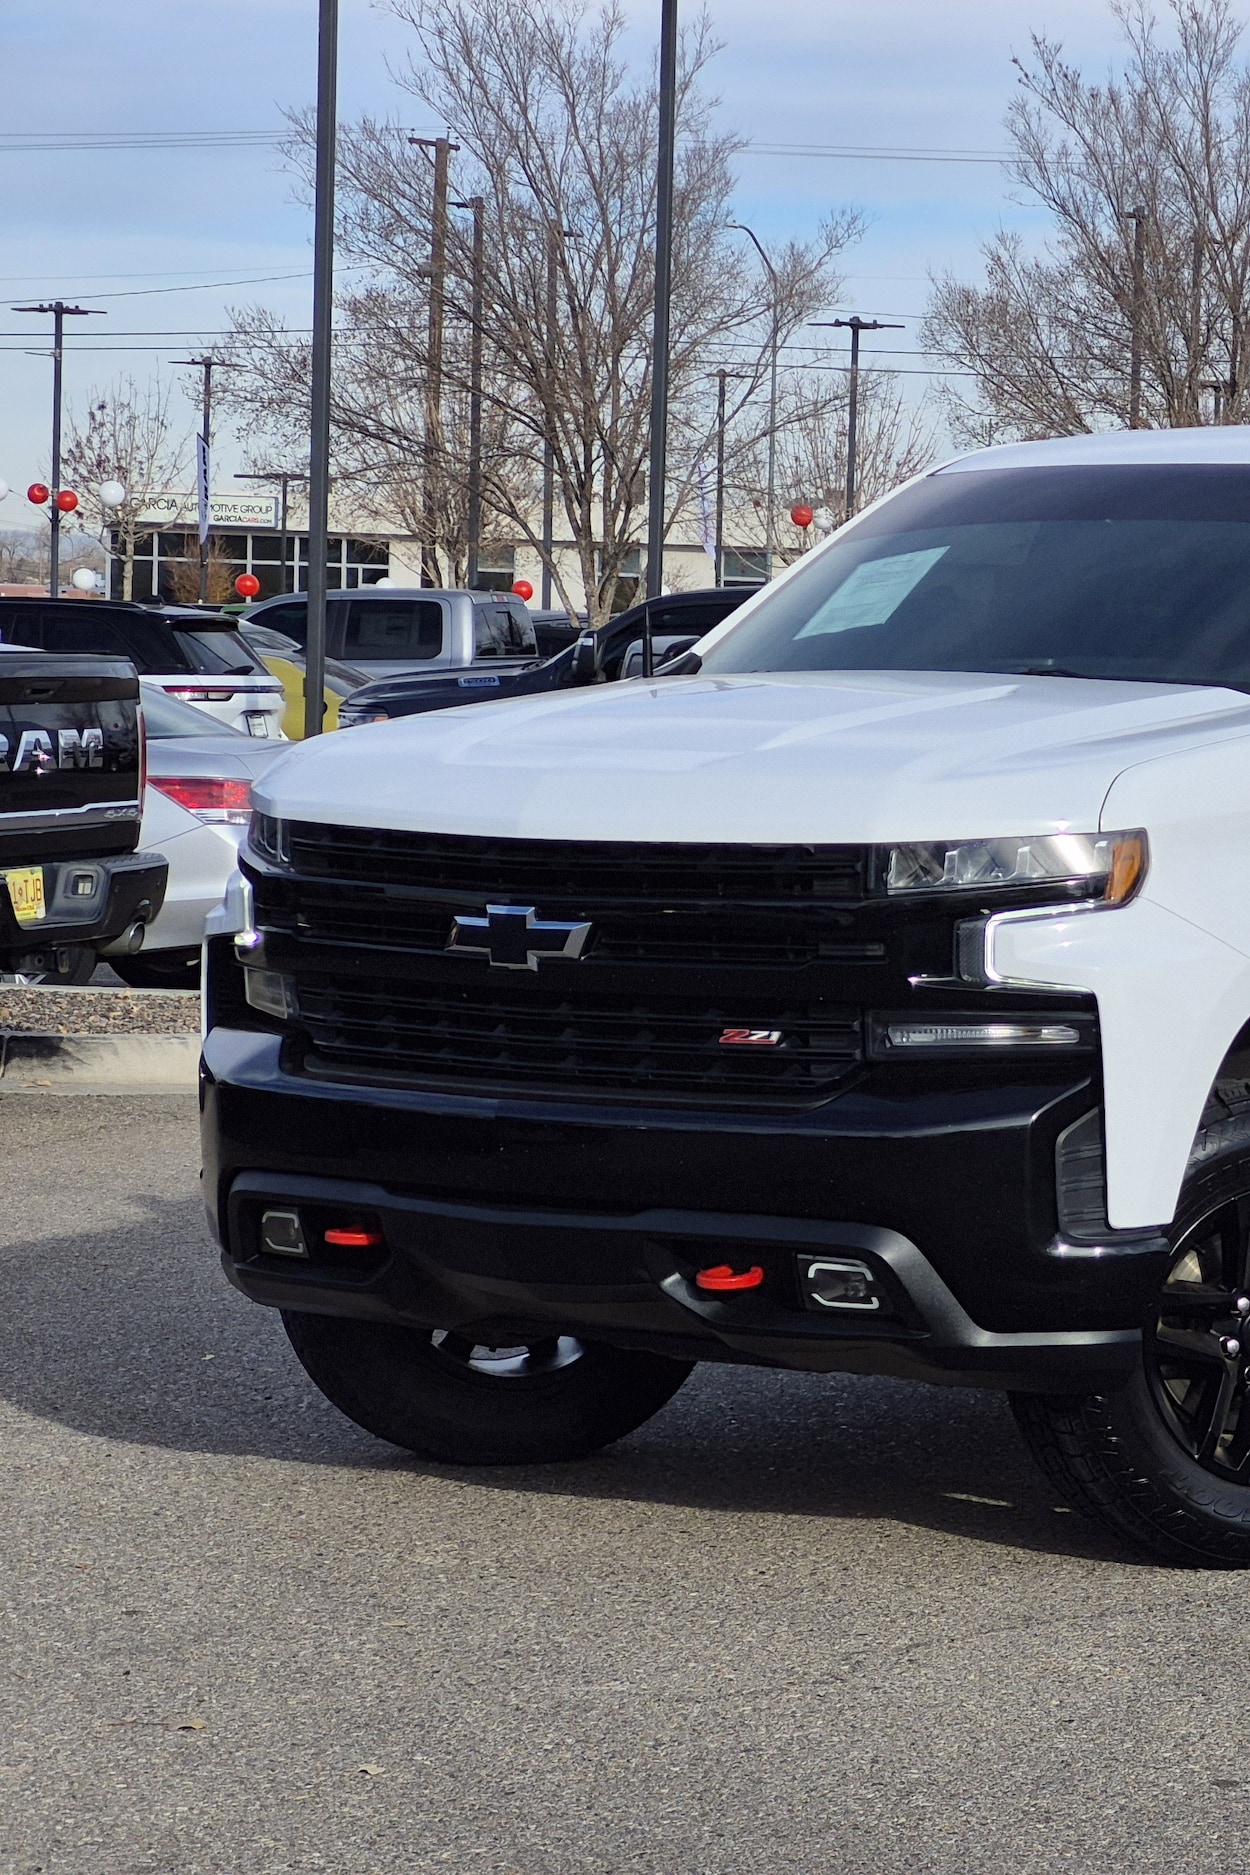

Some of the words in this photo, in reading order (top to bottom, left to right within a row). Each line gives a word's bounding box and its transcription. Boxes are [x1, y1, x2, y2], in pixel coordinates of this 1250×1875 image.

[130, 497, 178, 511] GARCIA
[184, 501, 239, 513] AUTOTIVE
[240, 504, 273, 514] GROUP
[0, 728, 104, 772] AM
[719, 1028, 782, 1045] Z71
